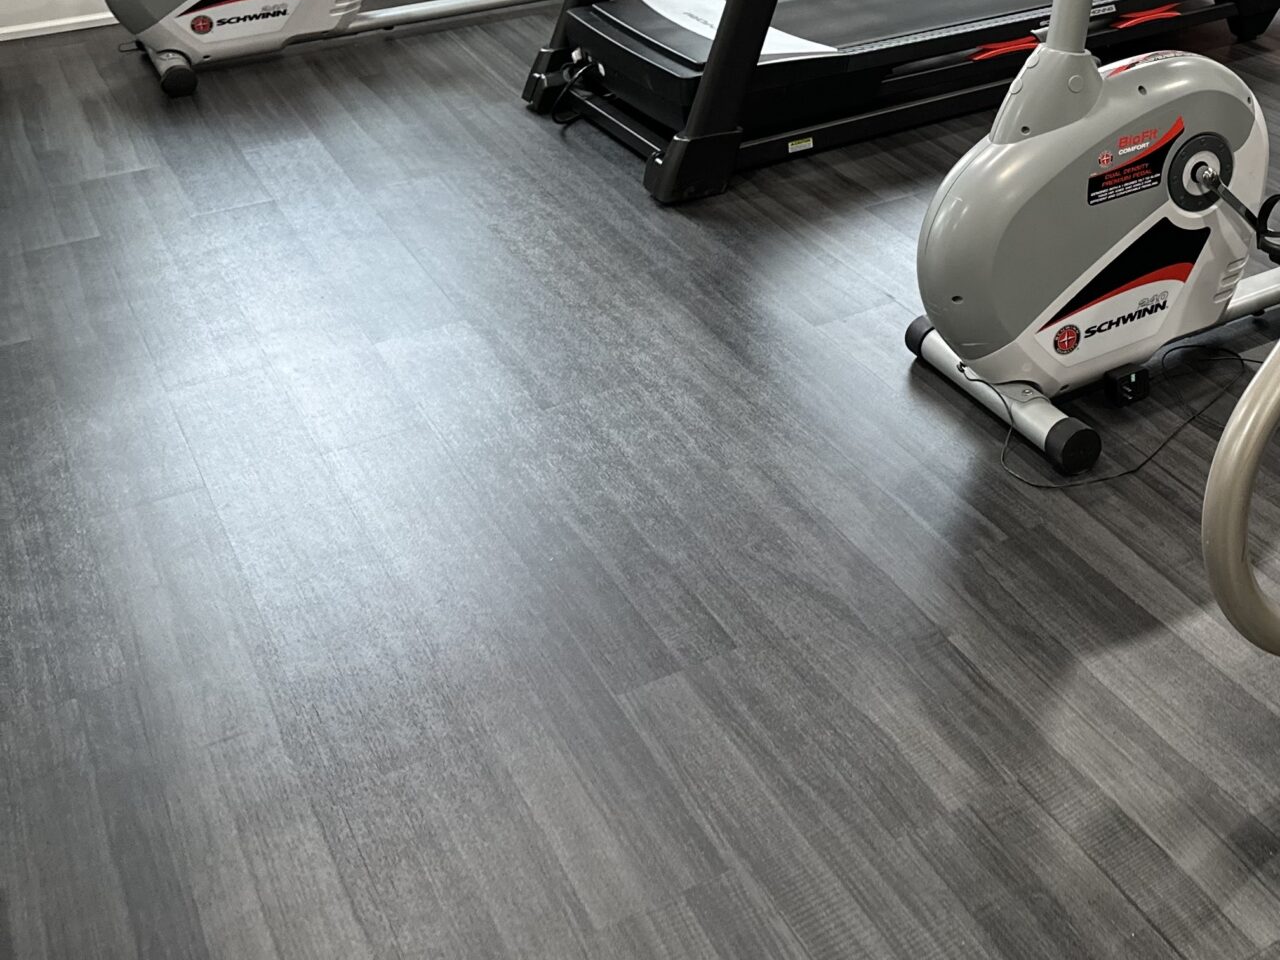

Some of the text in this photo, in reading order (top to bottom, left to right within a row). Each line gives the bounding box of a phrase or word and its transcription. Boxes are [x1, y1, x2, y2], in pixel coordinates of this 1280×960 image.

[216, 8, 288, 26] SCHWINN
[1118, 128, 1159, 147] BioFit
[1118, 142, 1150, 156] COMFORT
[1083, 300, 1168, 338] SCHWINN
